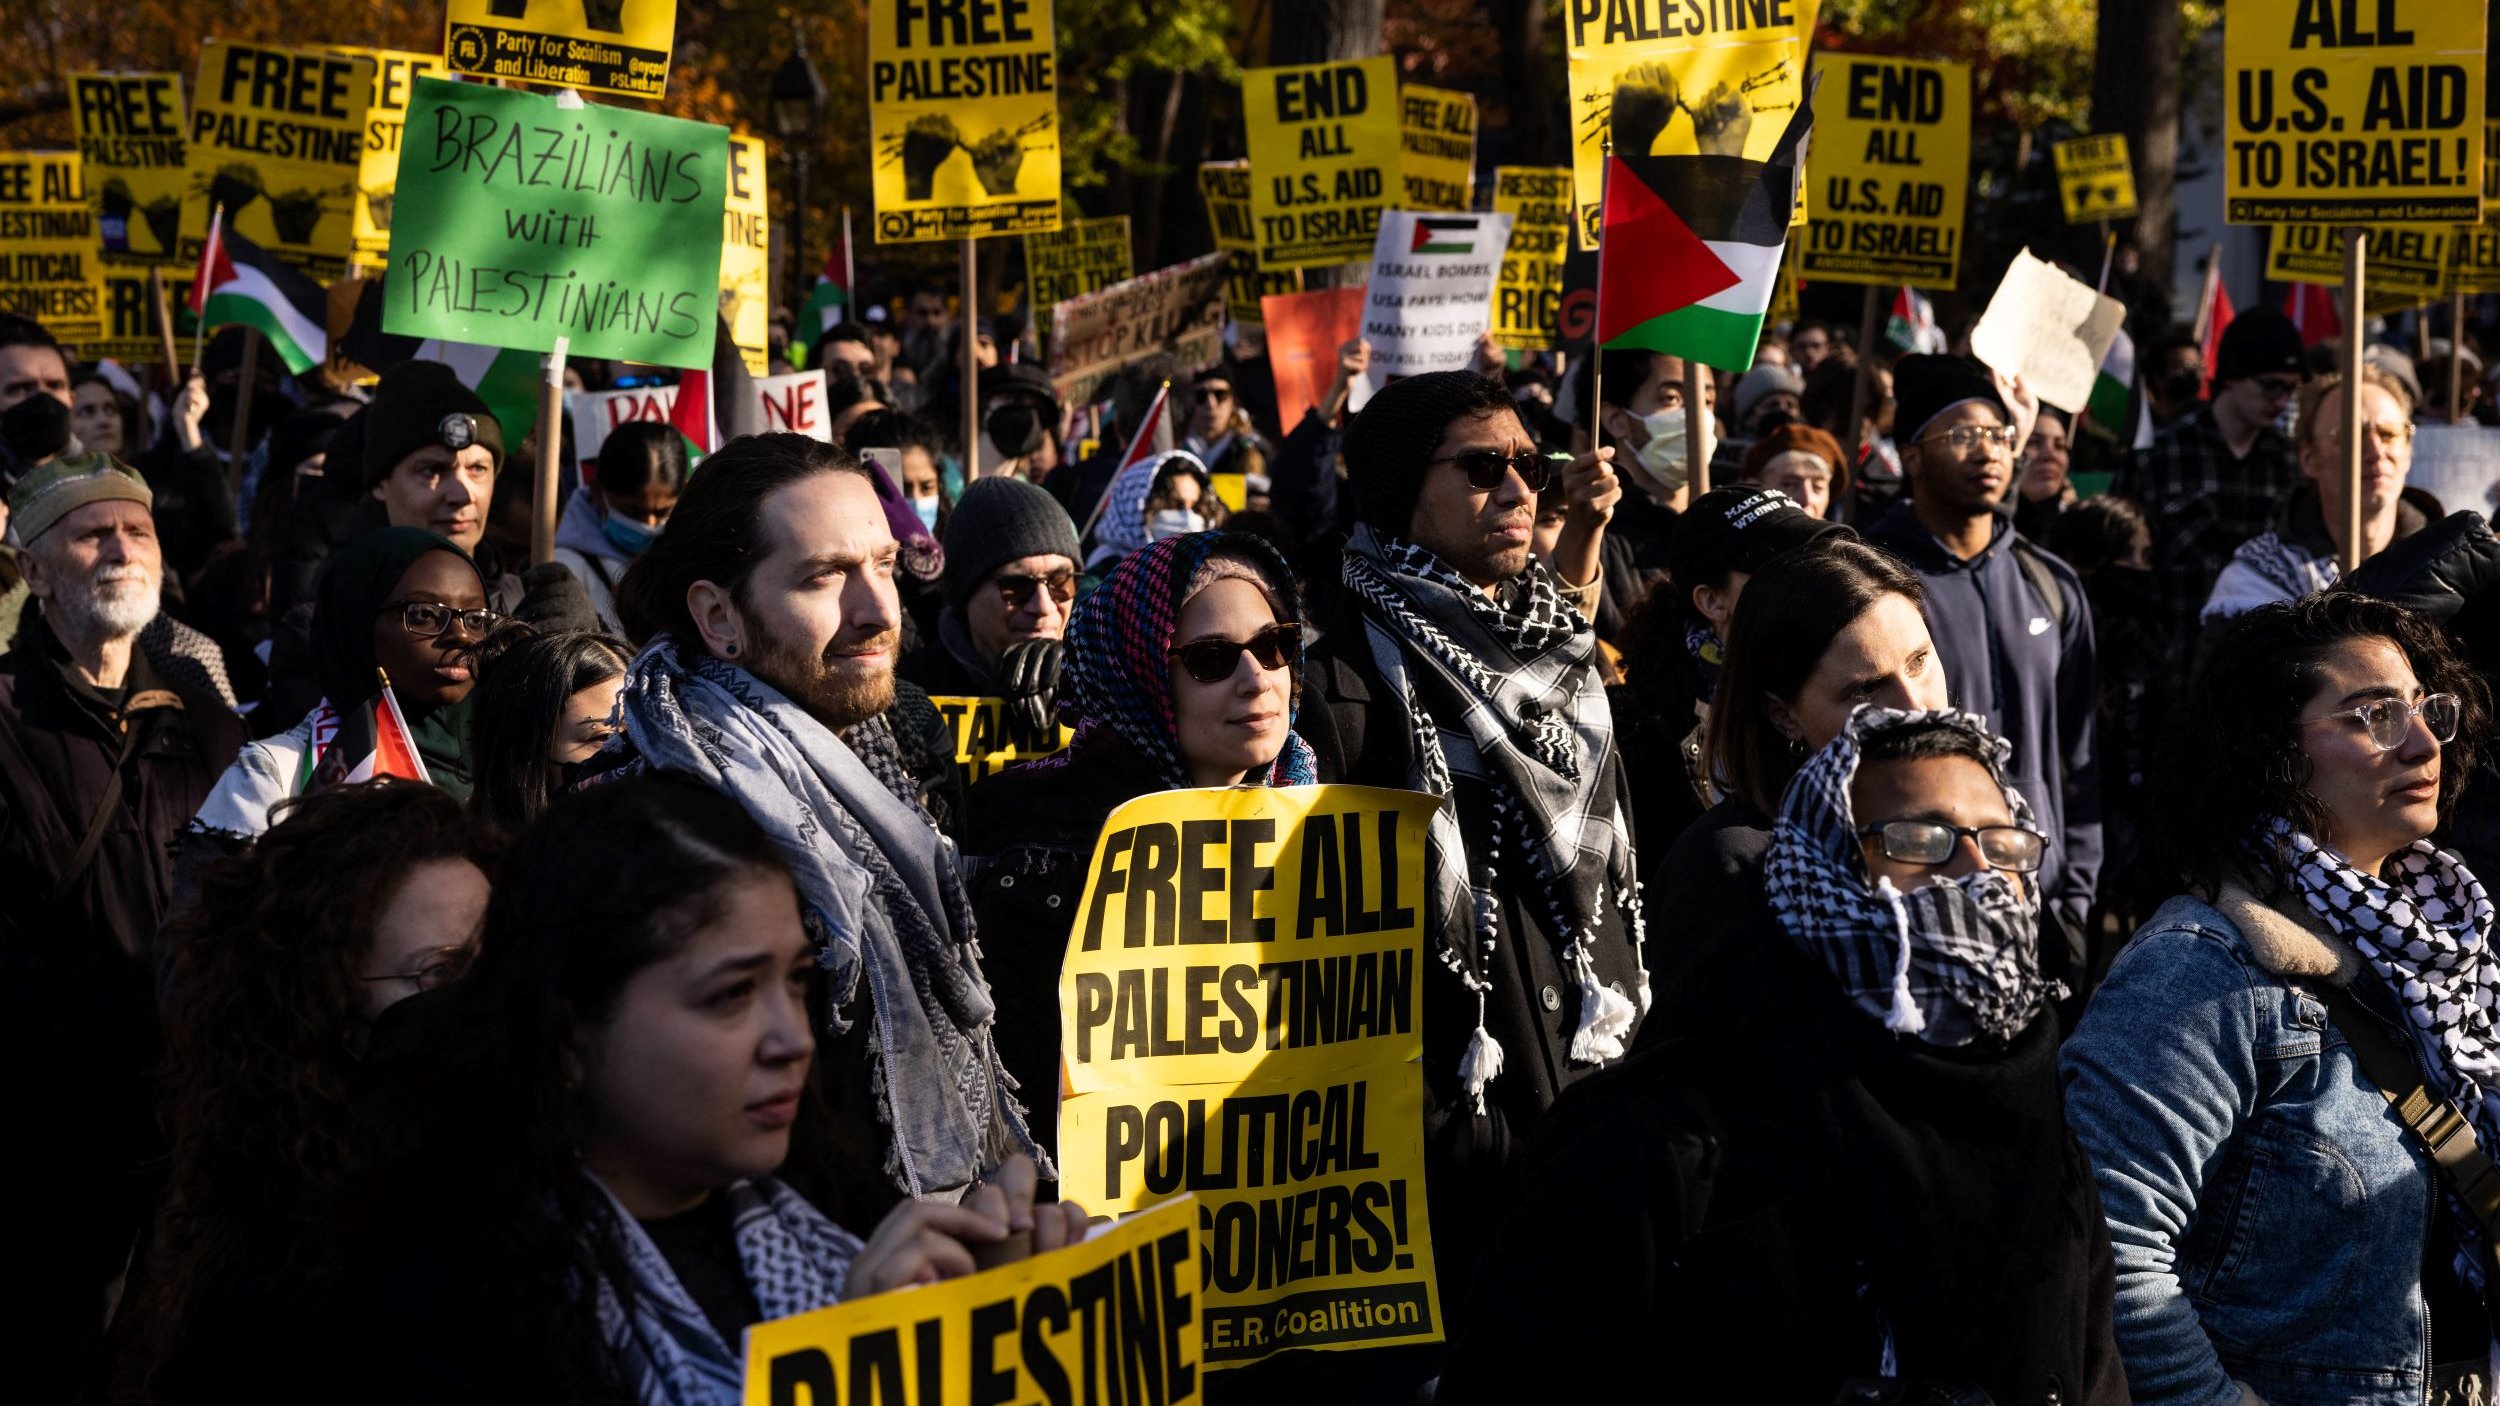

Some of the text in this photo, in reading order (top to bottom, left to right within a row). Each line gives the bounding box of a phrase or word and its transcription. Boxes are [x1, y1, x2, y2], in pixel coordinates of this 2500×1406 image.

[897, 0, 1033, 47] FREE
[1572, 0, 1795, 46] PALESTINE
[2290, 0, 2414, 48] ALL
[495, 57, 522, 75] and
[525, 58, 590, 85] Liberation
[496, 31, 535, 57] Party
[540, 36, 563, 56] for
[568, 41, 622, 66] Socialism
[221, 46, 352, 119] FREE
[874, 53, 1053, 102] PALESTINE
[1275, 66, 1368, 123] END
[1847, 63, 1944, 125] END
[2238, 65, 2467, 133] U.S. AID
[77, 78, 179, 135] FREE
[194, 110, 364, 167] PALESTINE
[1301, 125, 1353, 159] ALL
[1865, 130, 1922, 166] ALL
[2233, 140, 2283, 188] TO
[2296, 137, 2468, 188] ISRAEL!
[1273, 168, 1382, 206] U.S. AID
[1828, 177, 1944, 217] U.S. AID
[1262, 215, 1297, 243] TO
[2254, 205, 2286, 219] Party
[1809, 219, 1954, 259] TO ISRAEL!
[1724, 494, 1764, 520] MAKE
[1732, 500, 1782, 531] WRONG
[1081, 810, 1415, 952] FREE ALL
[1075, 948, 1414, 1064] PALESTINIAN
[1105, 1080, 1379, 1200] POLITICAL
[1274, 1298, 1420, 1338] Coalition
